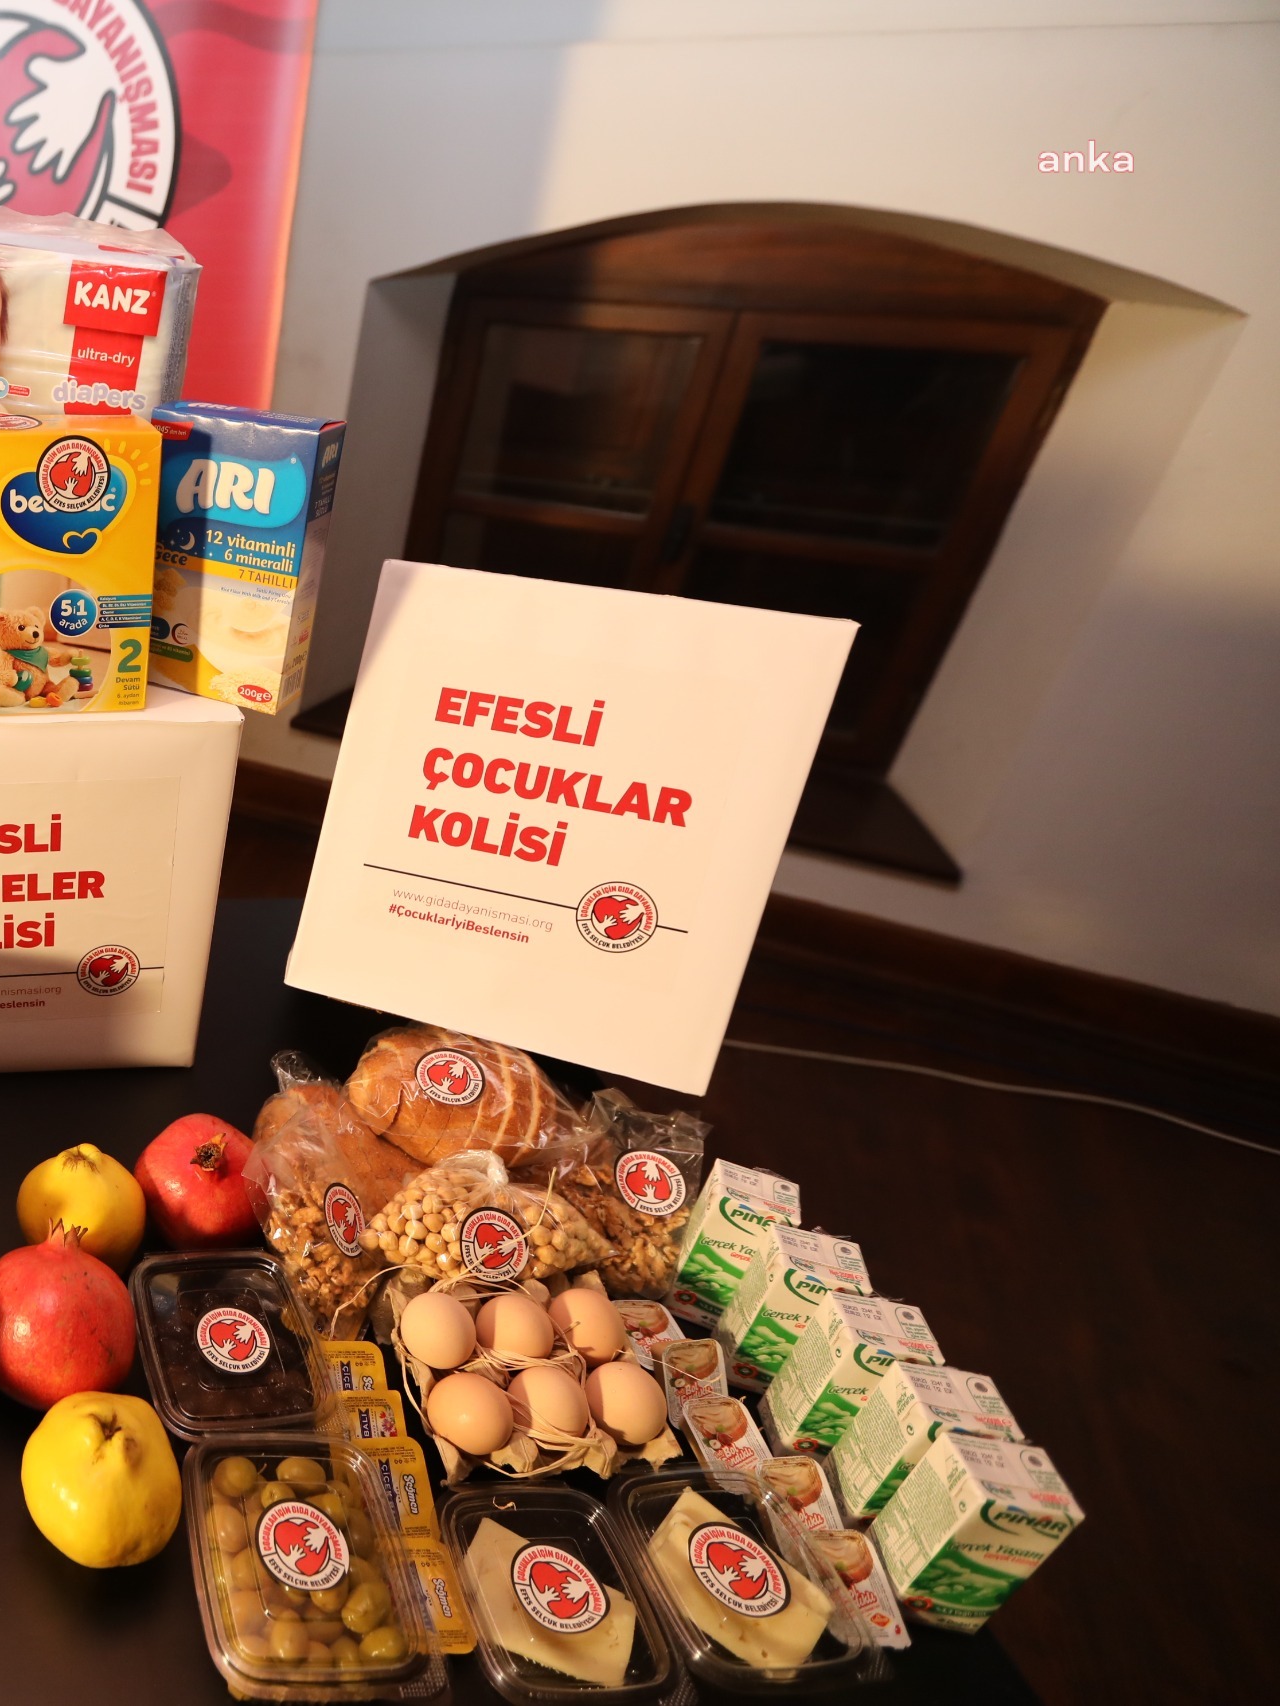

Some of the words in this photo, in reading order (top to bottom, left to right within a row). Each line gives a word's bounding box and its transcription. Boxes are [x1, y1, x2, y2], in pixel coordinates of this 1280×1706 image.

[54, 0, 160, 195] AYANIŞMASI
[73, 280, 151, 316] KANZ
[77, 347, 136, 368] ultra-dry
[52, 379, 147, 411] diapers
[175, 458, 276, 516] ARI
[206, 529, 223, 545] 12
[227, 534, 296, 559] vitaminli
[224, 549, 233, 560] 6
[235, 553, 293, 573] mineralli
[239, 569, 245, 579] 7
[247, 570, 293, 589] TAHILLI
[59, 618, 89, 630] arada
[117, 639, 142, 673] 2
[435, 686, 606, 747] EFESLİ
[422, 747, 693, 828] ÇOCUKLAR
[407, 804, 569, 867] KOLİSİ
[388, 903, 530, 944] #ÇocuklarİyiBeslensin
[392, 888, 554, 933] www.gidadayanismasi.org
[699, 1236, 737, 1250] Gerçek
[762, 1309, 802, 1322] Gerçek
[342, 1366, 351, 1390] ÇİÇE
[827, 1385, 869, 1395] Gerçek
[361, 1414, 370, 1437] BALI
[726, 1530, 747, 1545] GIDA
[700, 1571, 716, 1589] EFES
[714, 1587, 744, 1610] SELÇUK
[520, 1588, 533, 1606] EFES
[531, 1606, 558, 1627] SELÇUK
